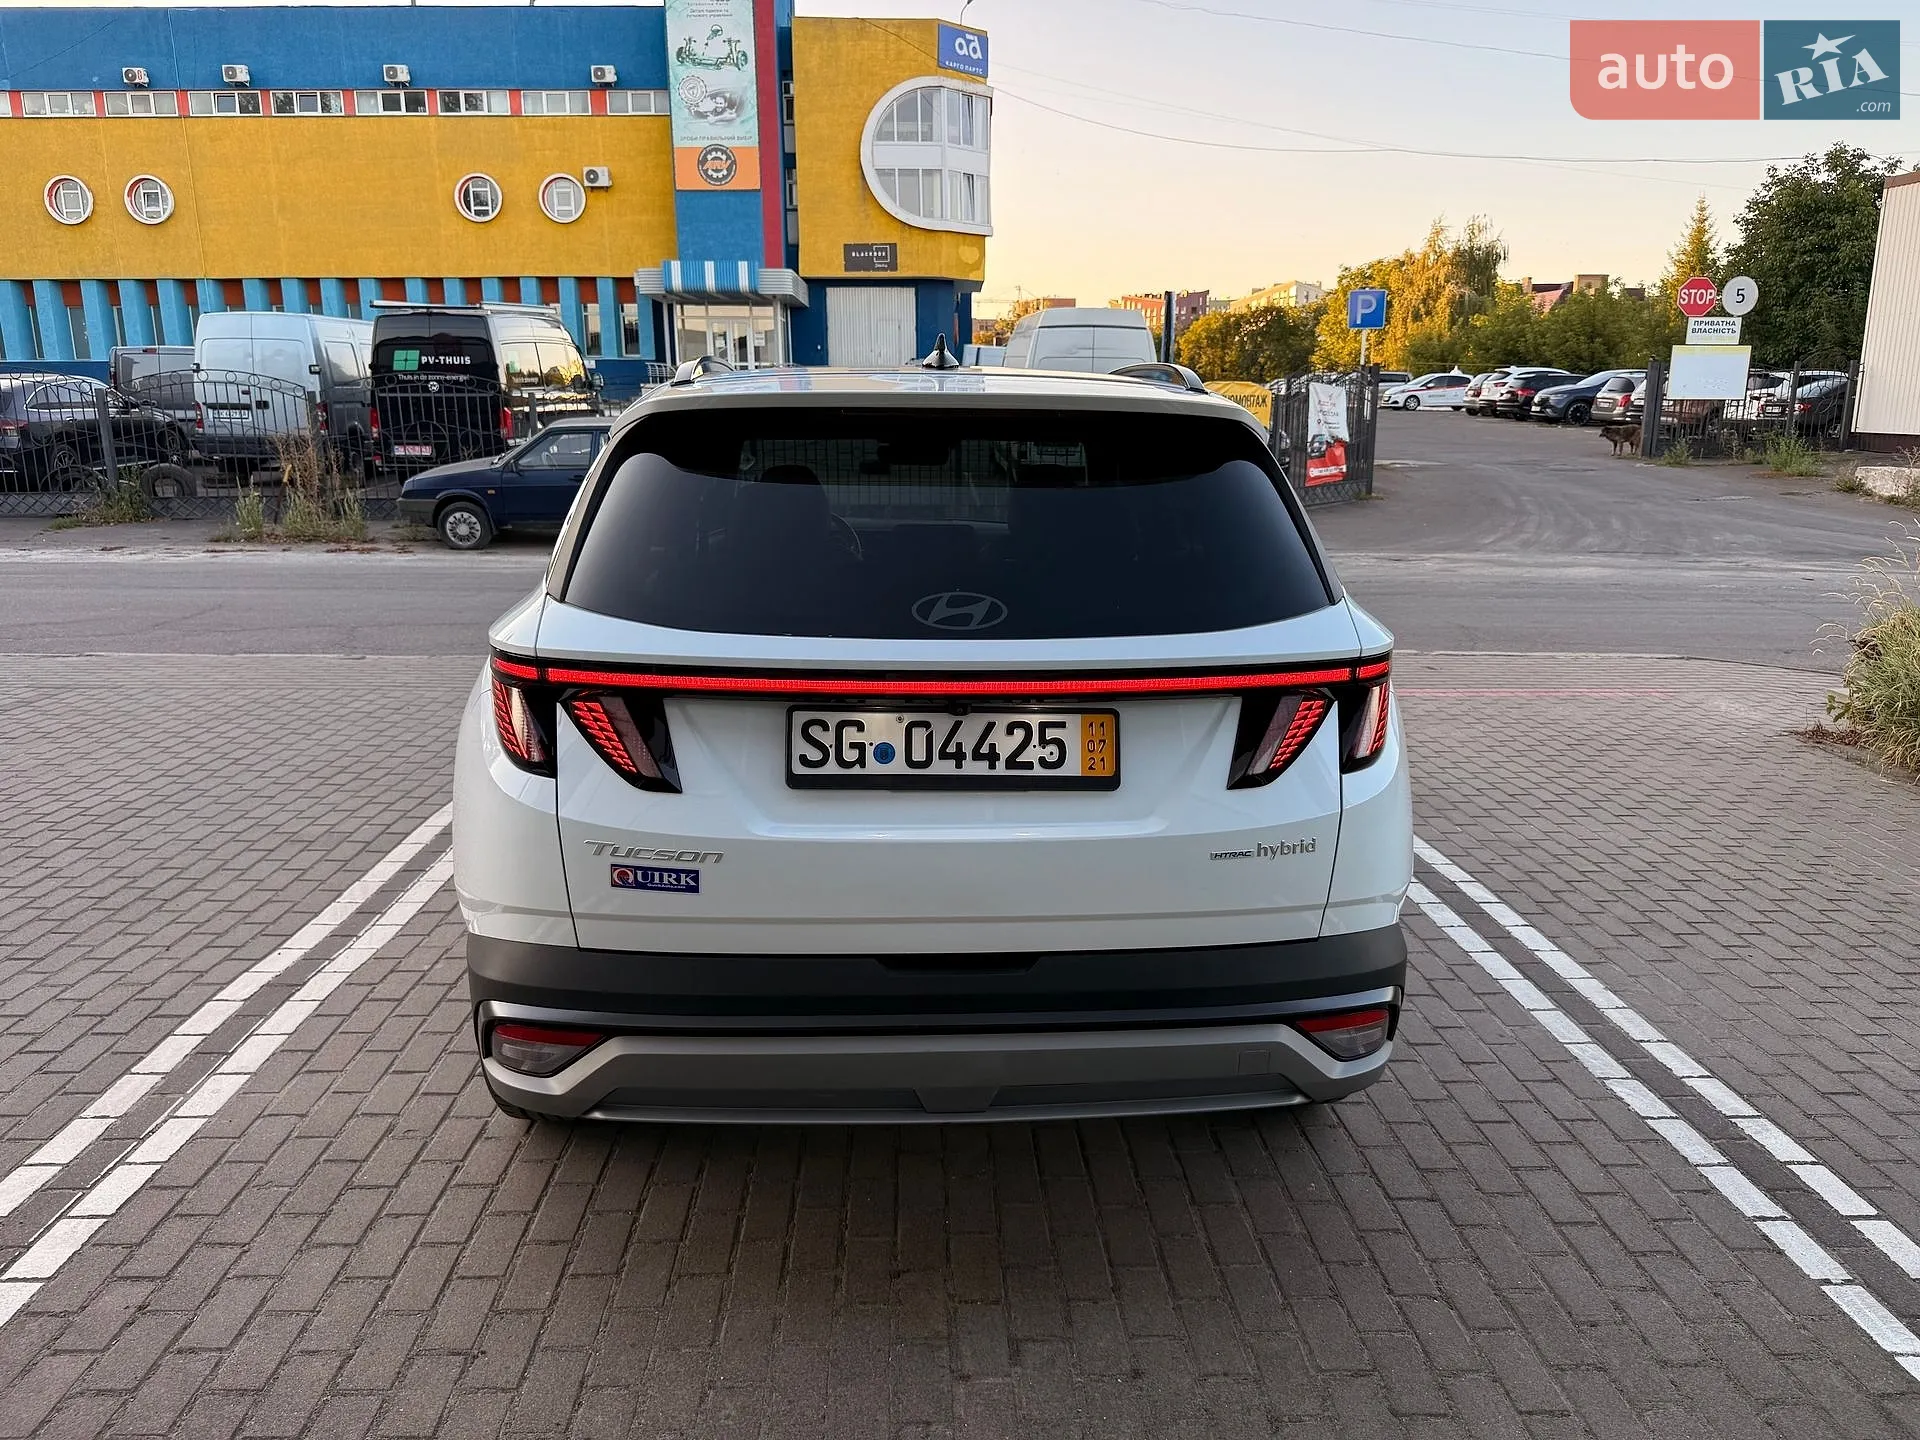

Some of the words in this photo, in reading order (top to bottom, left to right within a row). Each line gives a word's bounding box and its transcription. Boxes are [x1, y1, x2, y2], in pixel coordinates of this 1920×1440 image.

[1679, 289, 1716, 305] STOP
[1735, 288, 1746, 304] 5
[1356, 294, 1377, 324] P
[421, 355, 471, 365] PV-THUIS
[1088, 721, 1107, 736] 11
[799, 718, 867, 769] SG
[904, 719, 1068, 770] 04425
[1087, 739, 1107, 753] 07
[1087, 757, 1107, 771] 21
[1214, 850, 1253, 859] HTRAC
[1256, 837, 1317, 860] hybrid
[612, 866, 697, 887] QUIRK
